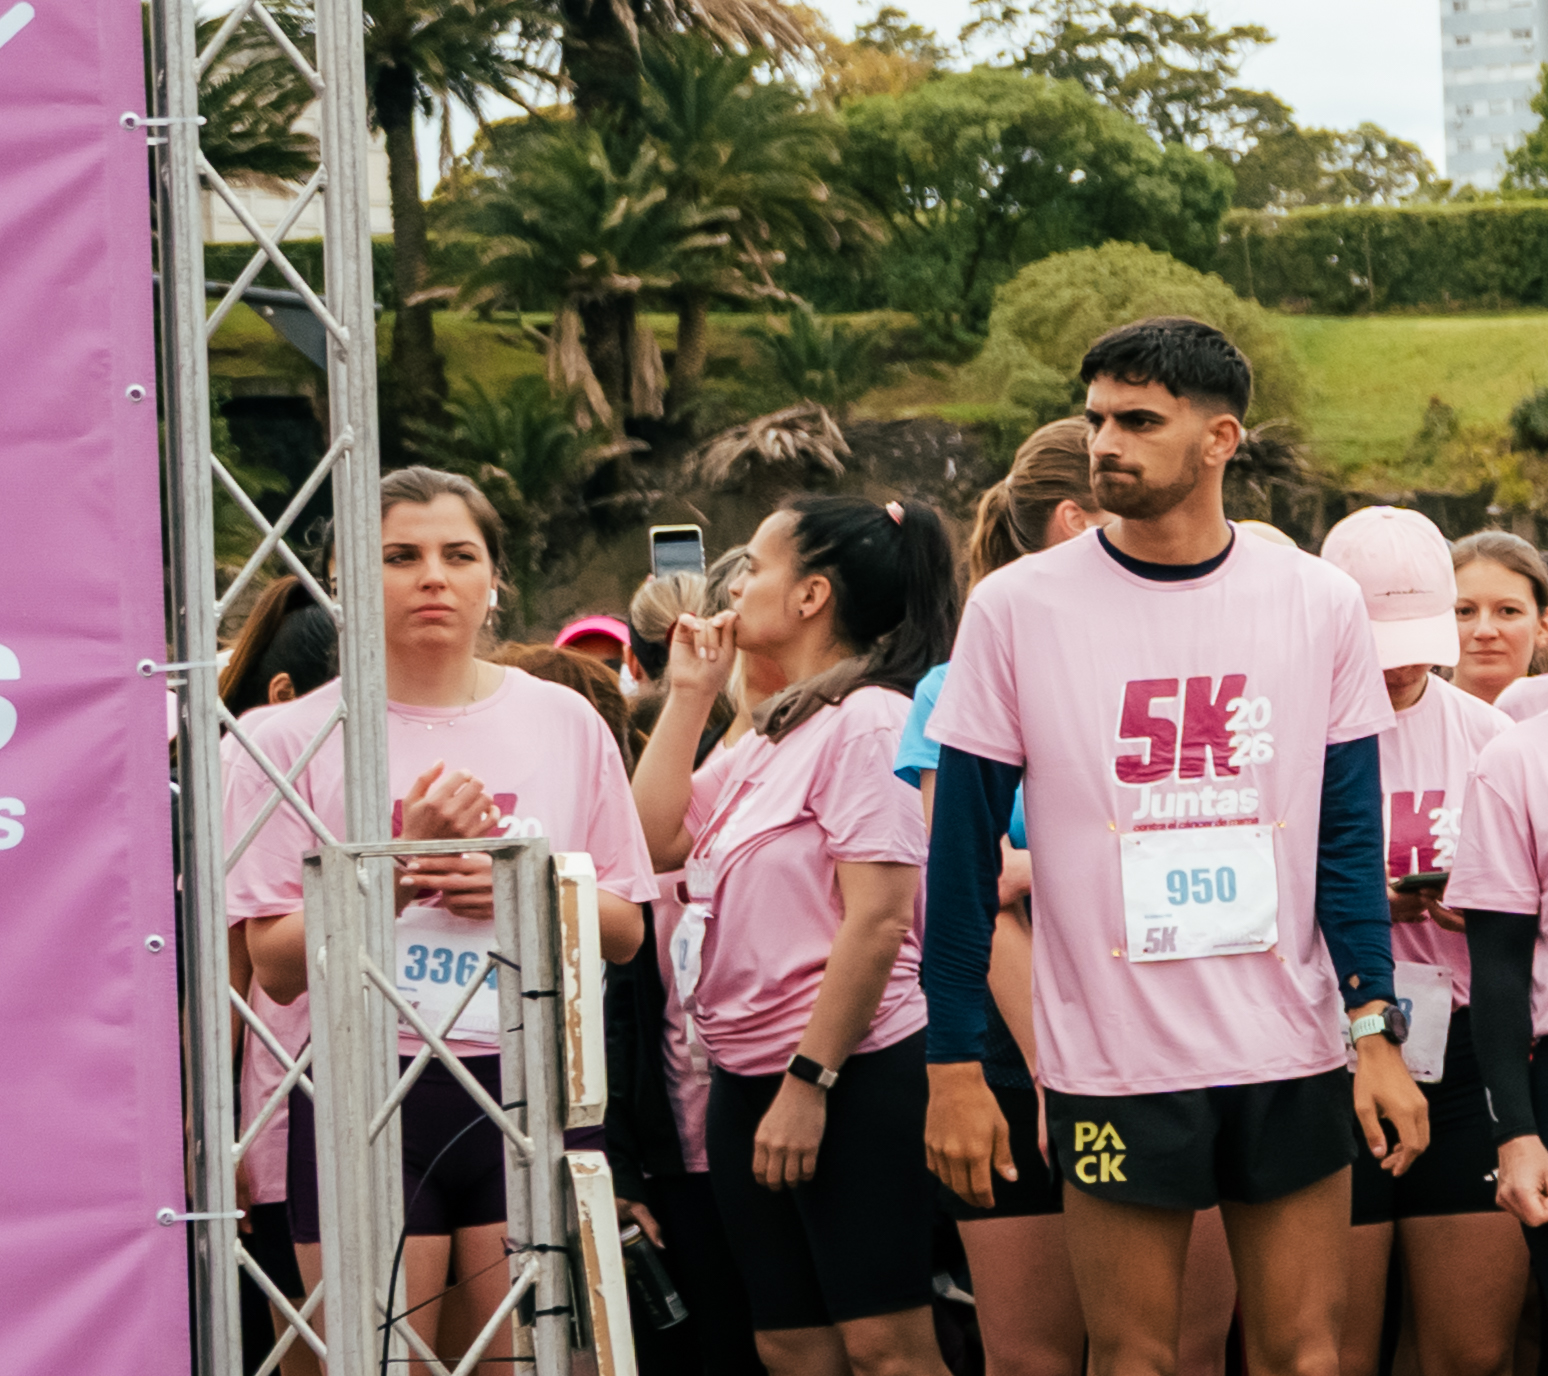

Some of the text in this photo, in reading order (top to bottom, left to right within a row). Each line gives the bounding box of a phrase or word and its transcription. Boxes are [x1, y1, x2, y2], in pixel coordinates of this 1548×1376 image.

[1111, 674, 1272, 787] 5K 20
[1227, 732, 1274, 767] 26
[1132, 784, 1259, 820] Juntas
[1166, 866, 1237, 906] 950
[1144, 925, 1179, 954] 5K
[1075, 1120, 1127, 1152] PA
[1075, 1152, 1128, 1184] CK
